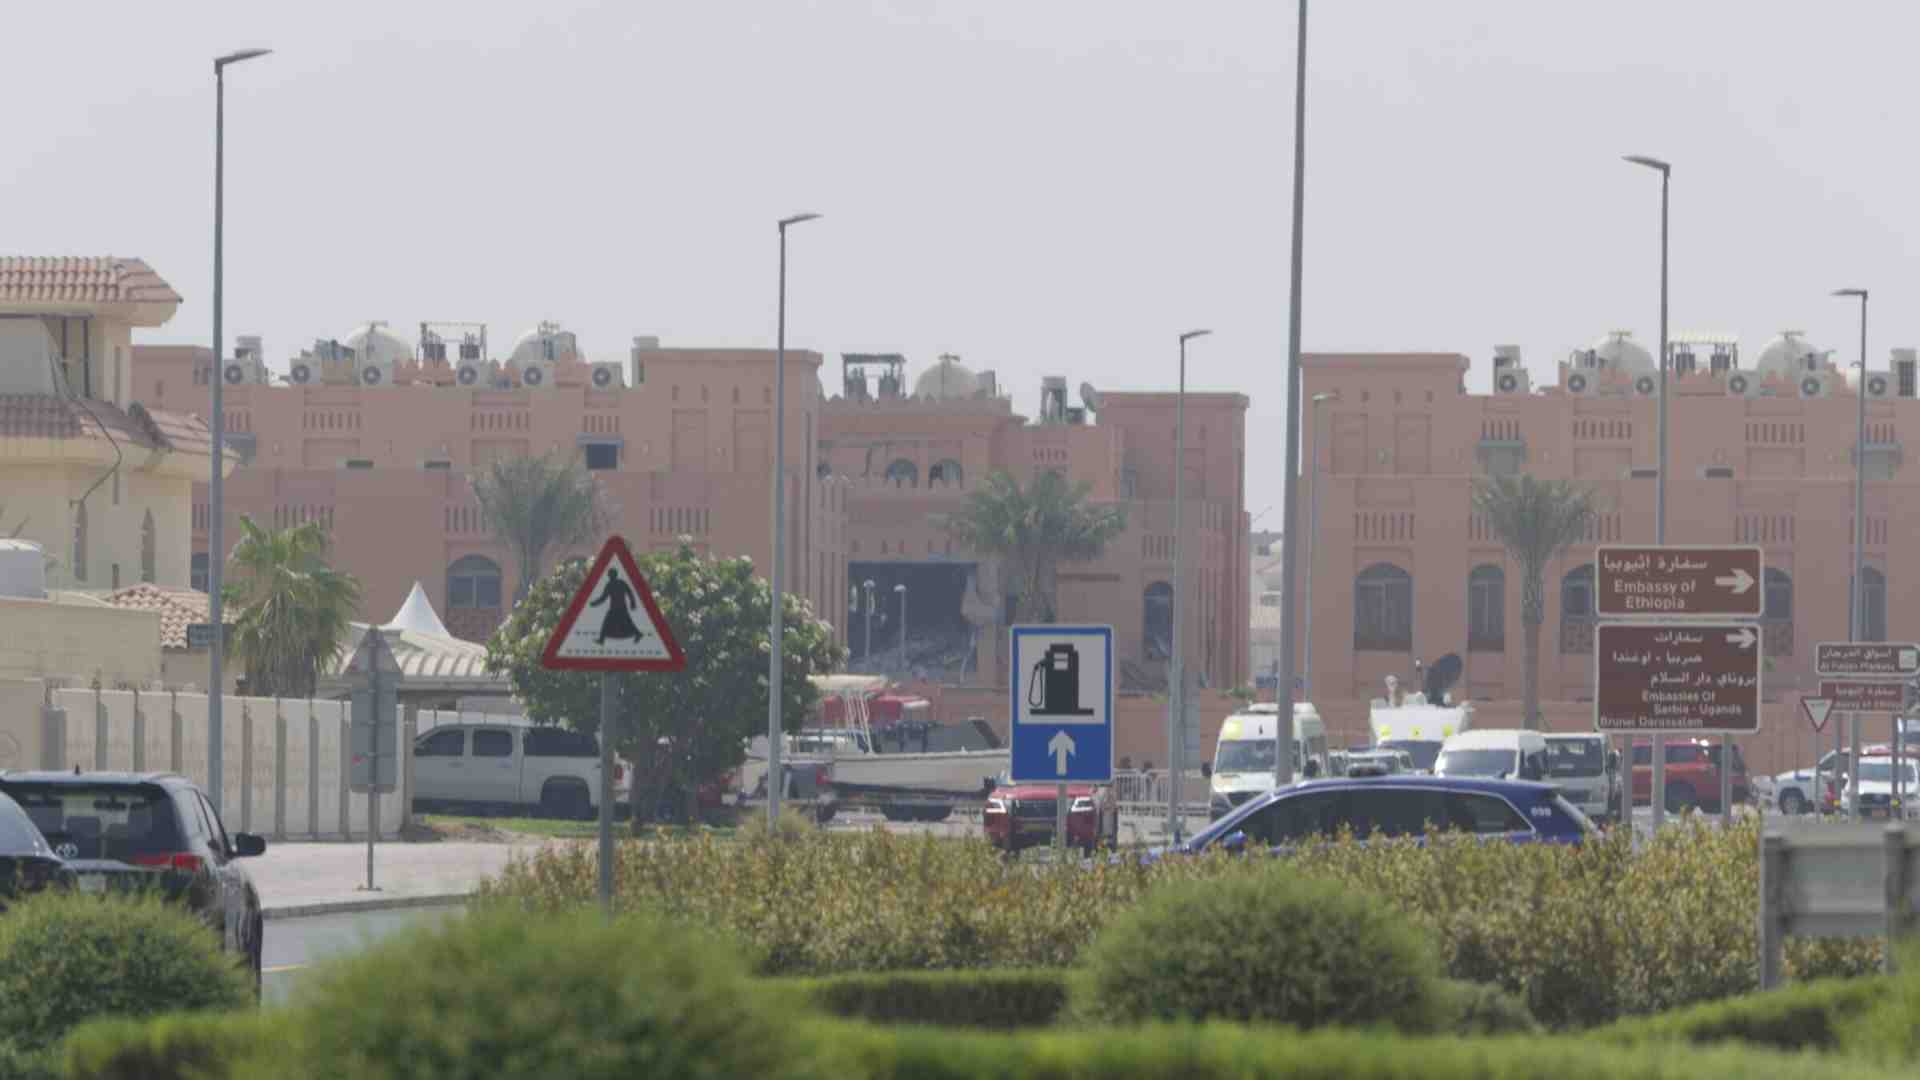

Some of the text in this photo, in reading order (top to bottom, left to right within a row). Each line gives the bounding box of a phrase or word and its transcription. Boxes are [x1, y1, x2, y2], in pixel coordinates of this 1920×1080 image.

[1657, 554, 1708, 572] سفارة
[1614, 578, 1696, 594] Embassy of
[1626, 595, 1686, 610] Ethiopia
[1654, 631, 1704, 646] سفارات
[1650, 672, 1690, 688] السلام
[1693, 672, 1712, 687] دار
[1641, 690, 1700, 702] Embassies
[1654, 703, 1690, 715] Serbia
[1700, 703, 1742, 717] Uganda
